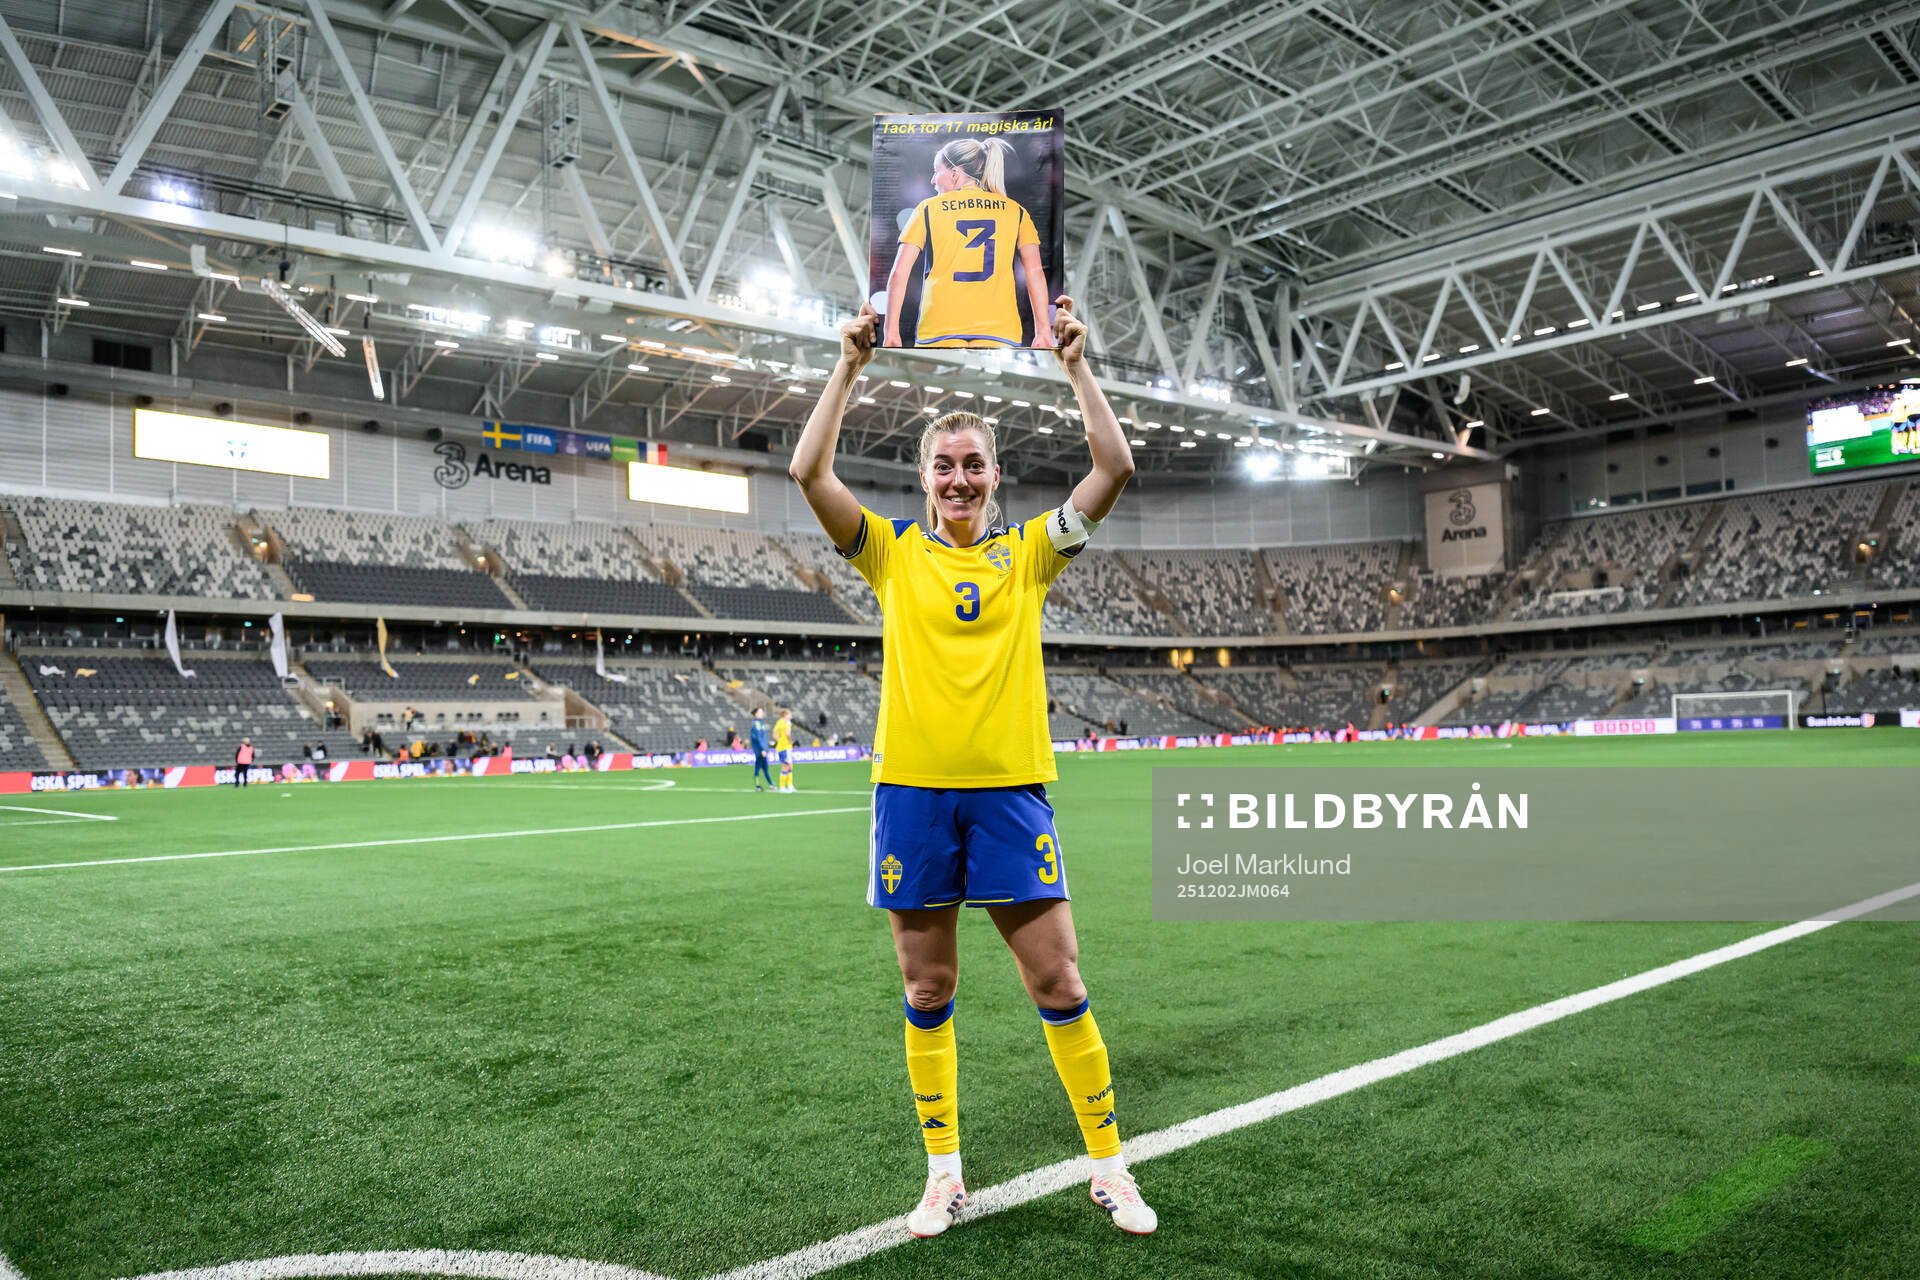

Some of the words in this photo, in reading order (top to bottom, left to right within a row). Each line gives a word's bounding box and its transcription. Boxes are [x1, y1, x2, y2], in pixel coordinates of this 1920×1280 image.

[882, 121, 916, 134] Tack
[946, 121, 963, 133] 17
[966, 120, 1029, 135] magiska
[941, 199, 1007, 212] SEMBRANT
[953, 219, 996, 282] 3
[526, 433, 552, 447] FIFA
[585, 441, 611, 453] UEFA
[473, 453, 551, 485] Arena
[1441, 526, 1488, 543] Arena
[955, 581, 980, 622] 3
[708, 752, 731, 764] UEFA
[814, 750, 846, 761] LEAGUE
[67, 774, 99, 789] SPEL
[1035, 833, 1059, 884] 3
